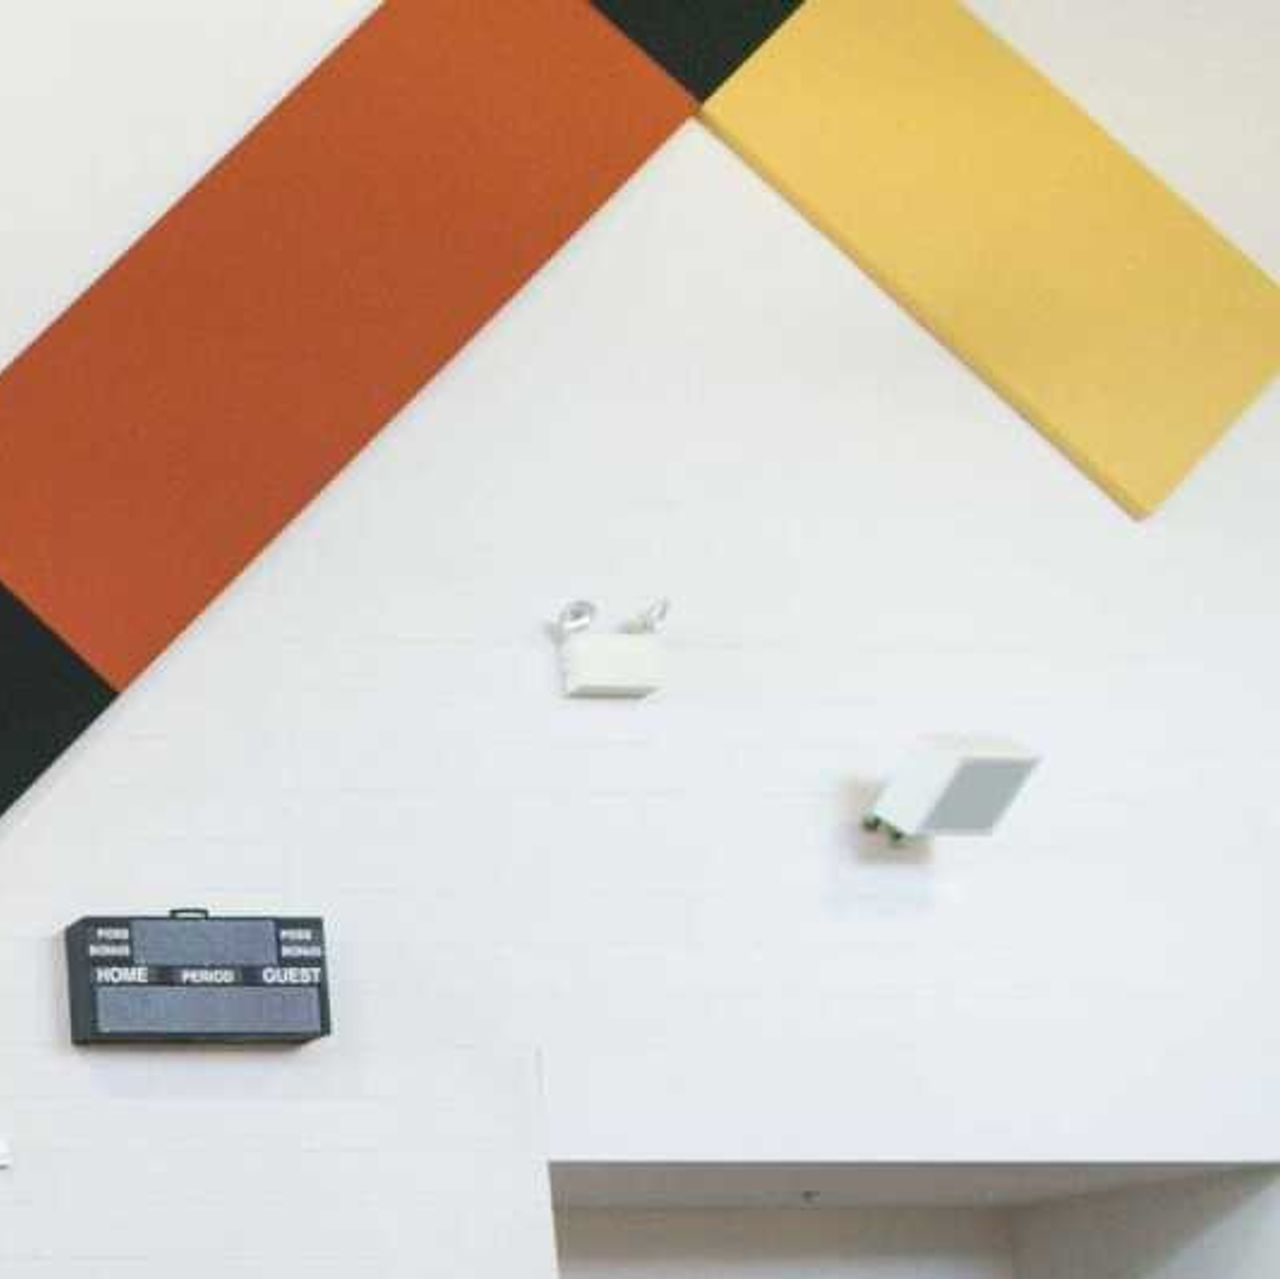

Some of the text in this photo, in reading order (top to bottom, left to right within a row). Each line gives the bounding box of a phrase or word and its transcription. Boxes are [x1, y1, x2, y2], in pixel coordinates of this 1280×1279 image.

[96, 967, 321, 983] HOME PERIOD GUEST
